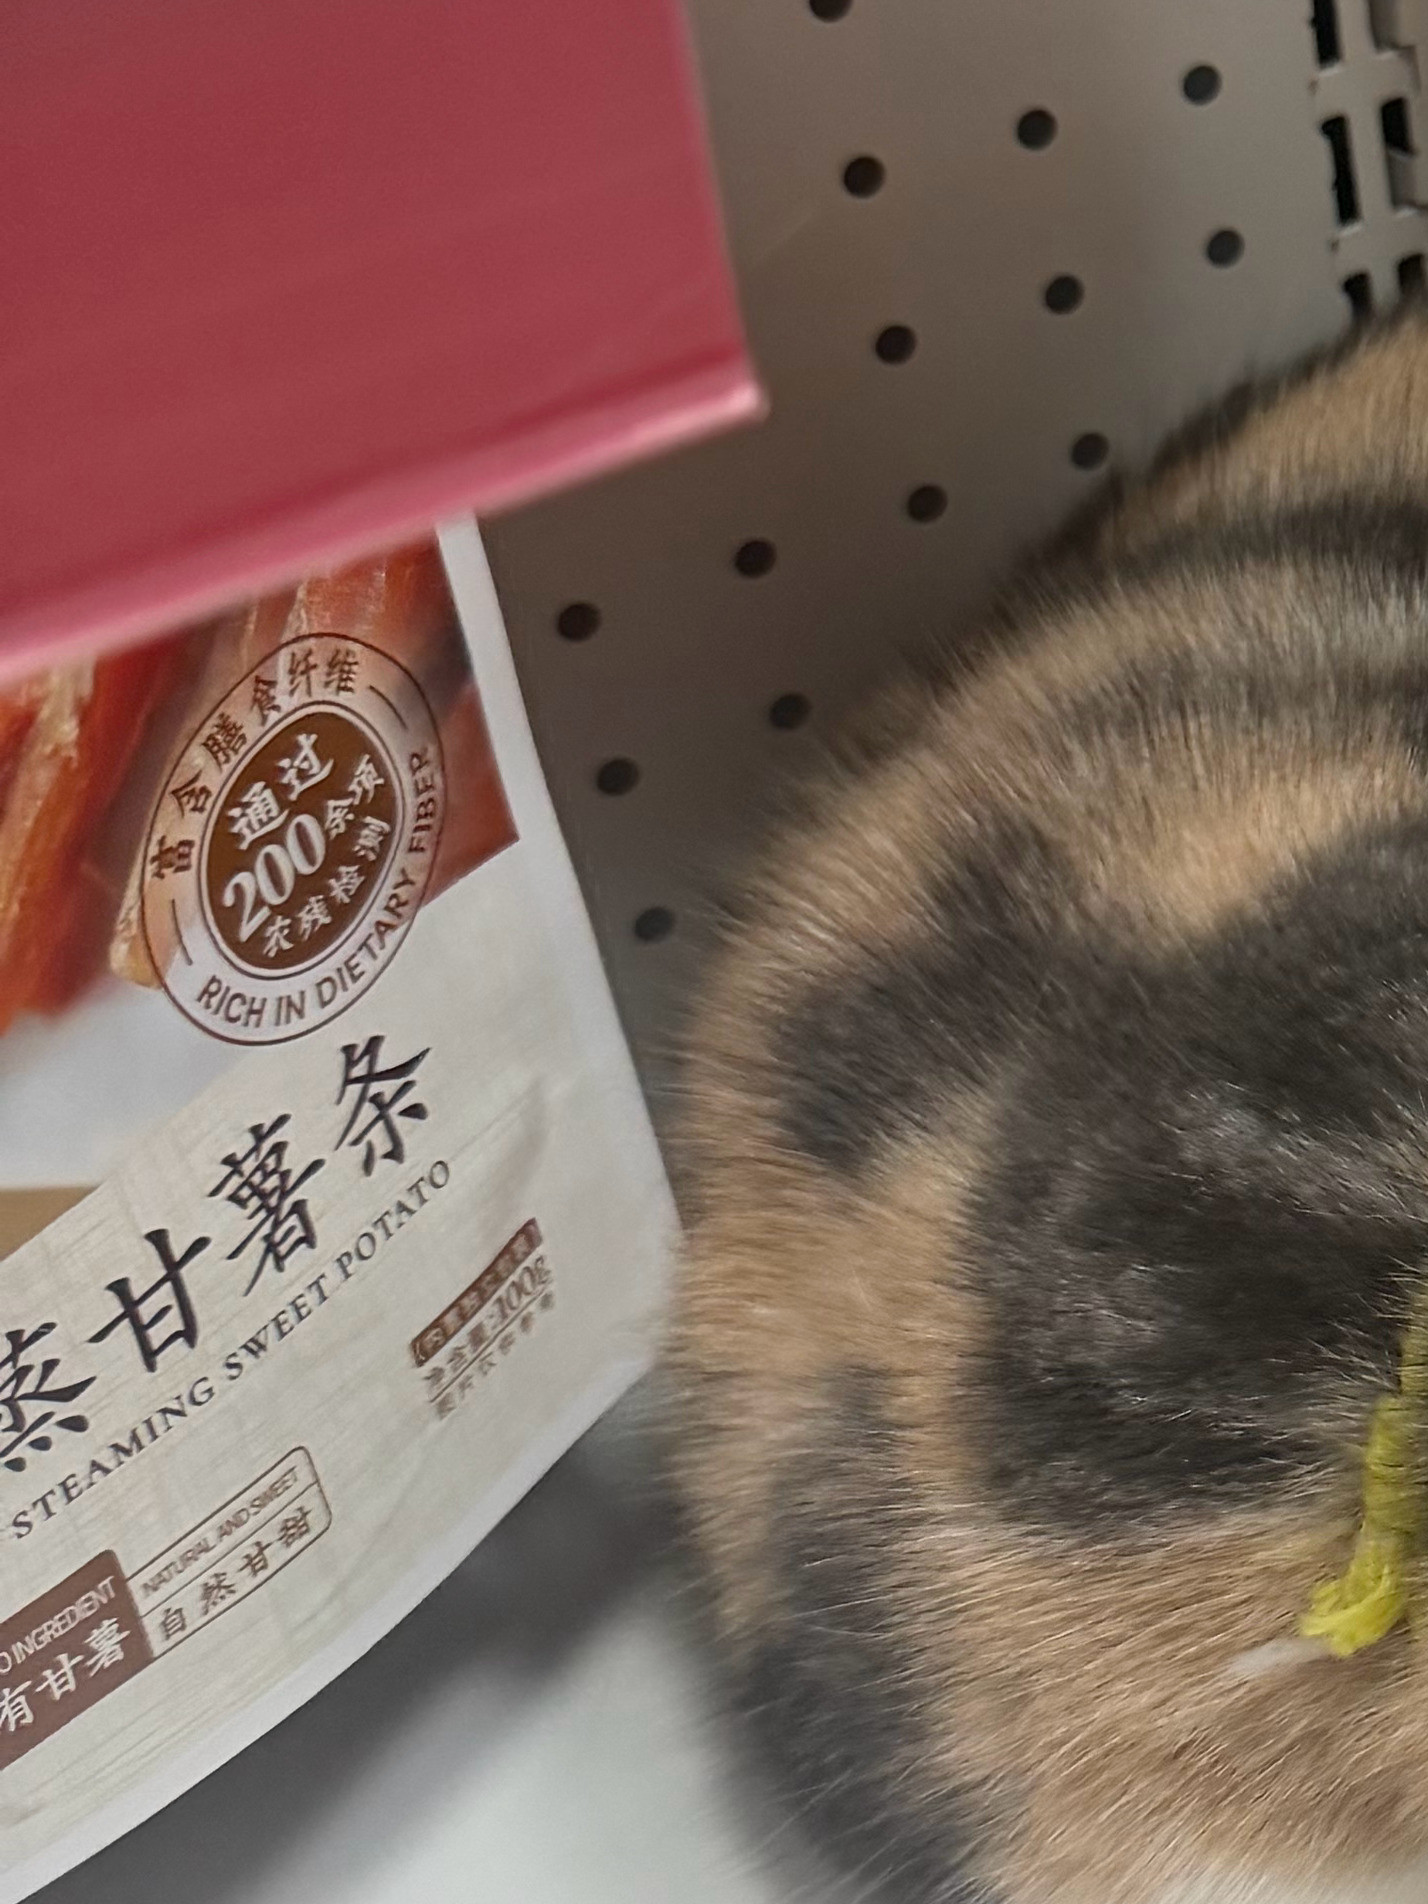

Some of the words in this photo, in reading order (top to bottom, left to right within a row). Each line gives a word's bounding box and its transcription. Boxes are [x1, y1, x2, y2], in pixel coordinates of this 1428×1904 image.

[150, 648, 360, 881] 富含膳食纤维
[226, 733, 335, 851] 通过
[196, 974, 266, 1029] RICH
[274, 991, 306, 1028] IN
[315, 868, 417, 1009] DIETARY
[406, 746, 441, 854] FIBER
[0, 1033, 432, 1474] 蒸甘薯条
[11, 1374, 217, 1541] STEAMING
[223, 1278, 331, 1383] SWEET
[334, 1159, 453, 1279] POTATO
[140, 1536, 217, 1594] NATURAL
[216, 1507, 251, 1544] AND
[248, 1465, 299, 1518] SWEET
[159, 1505, 313, 1642] 自然甘甜
[0, 1618, 131, 1733] 有甘薯
[11, 1576, 117, 1665] INGREDIENT
